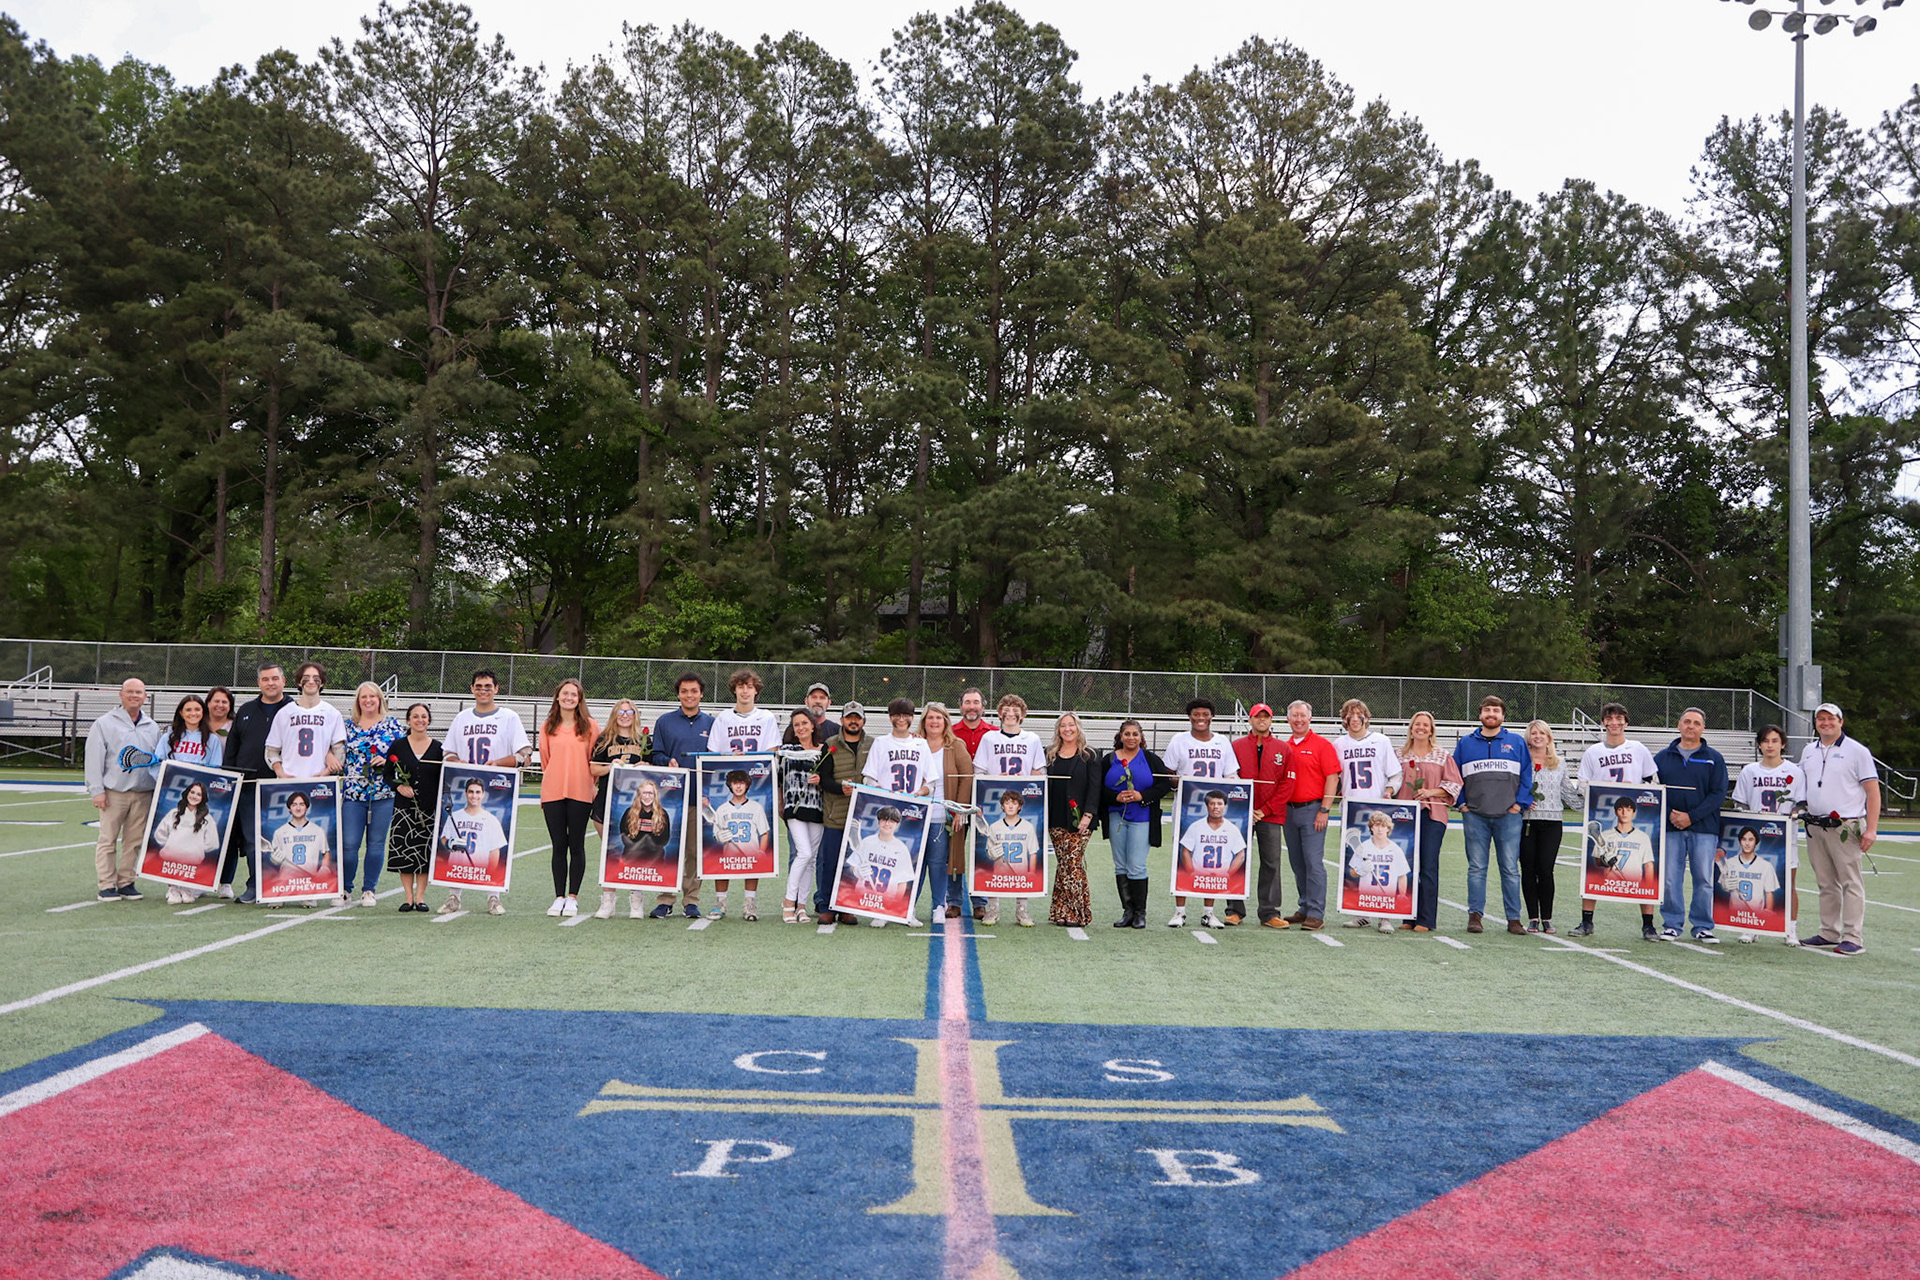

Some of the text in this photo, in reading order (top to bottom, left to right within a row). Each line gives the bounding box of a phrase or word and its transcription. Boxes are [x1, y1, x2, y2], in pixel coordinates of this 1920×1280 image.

[290, 715, 324, 726] EAGLES
[464, 724, 497, 736] EAGLES
[728, 725, 761, 737] EAGLES
[298, 728, 314, 757] 8
[468, 737, 491, 765] 16
[994, 744, 1027, 754] EAGLES
[1188, 748, 1222, 759] EAGLES
[1344, 748, 1376, 759] EAGLES
[889, 750, 920, 762] EAGLES
[1599, 753, 1632, 767] EAGLES
[1000, 757, 1022, 775] 12
[1472, 761, 1508, 770] MEMPHIS
[891, 764, 918, 794] 39
[1350, 761, 1372, 789] 15
[1609, 767, 1624, 782] 7
[1753, 777, 1787, 787] EAGLES
[1761, 790, 1776, 812] 9
[457, 821, 483, 831] EAGLES
[728, 821, 751, 843] 23
[1201, 834, 1228, 843] EAGLES
[292, 844, 306, 865] 8
[1002, 842, 1022, 863] 12
[1203, 846, 1222, 869] 21
[868, 853, 897, 867] EAGLES
[1617, 850, 1631, 870] 7
[162, 867, 196, 879] DUFFEE
[163, 861, 197, 873] MADDIE
[452, 865, 486, 874] JOSEPH
[624, 866, 658, 875] RACHEL
[288, 877, 311, 885] MIKE
[446, 871, 491, 882] McCUSKER
[618, 871, 663, 882] SCHIRMER
[272, 882, 327, 893] HOFFMEYER
[1193, 882, 1228, 890] PARKER
[1589, 884, 1655, 895] FRANCESCHINI
[1604, 879, 1639, 888] JOSEPH
[863, 893, 883, 901] LUIS
[1739, 881, 1753, 901] 9
[859, 899, 884, 910] VIDAL
[1358, 901, 1395, 910] McALPIN
[1737, 910, 1756, 918] WILL
[1730, 916, 1765, 926] DABNEY
[733, 1050, 827, 1073] C
[1104, 1059, 1174, 1082] S
[672, 1139, 795, 1177] P
[1137, 1149, 1261, 1186] B
